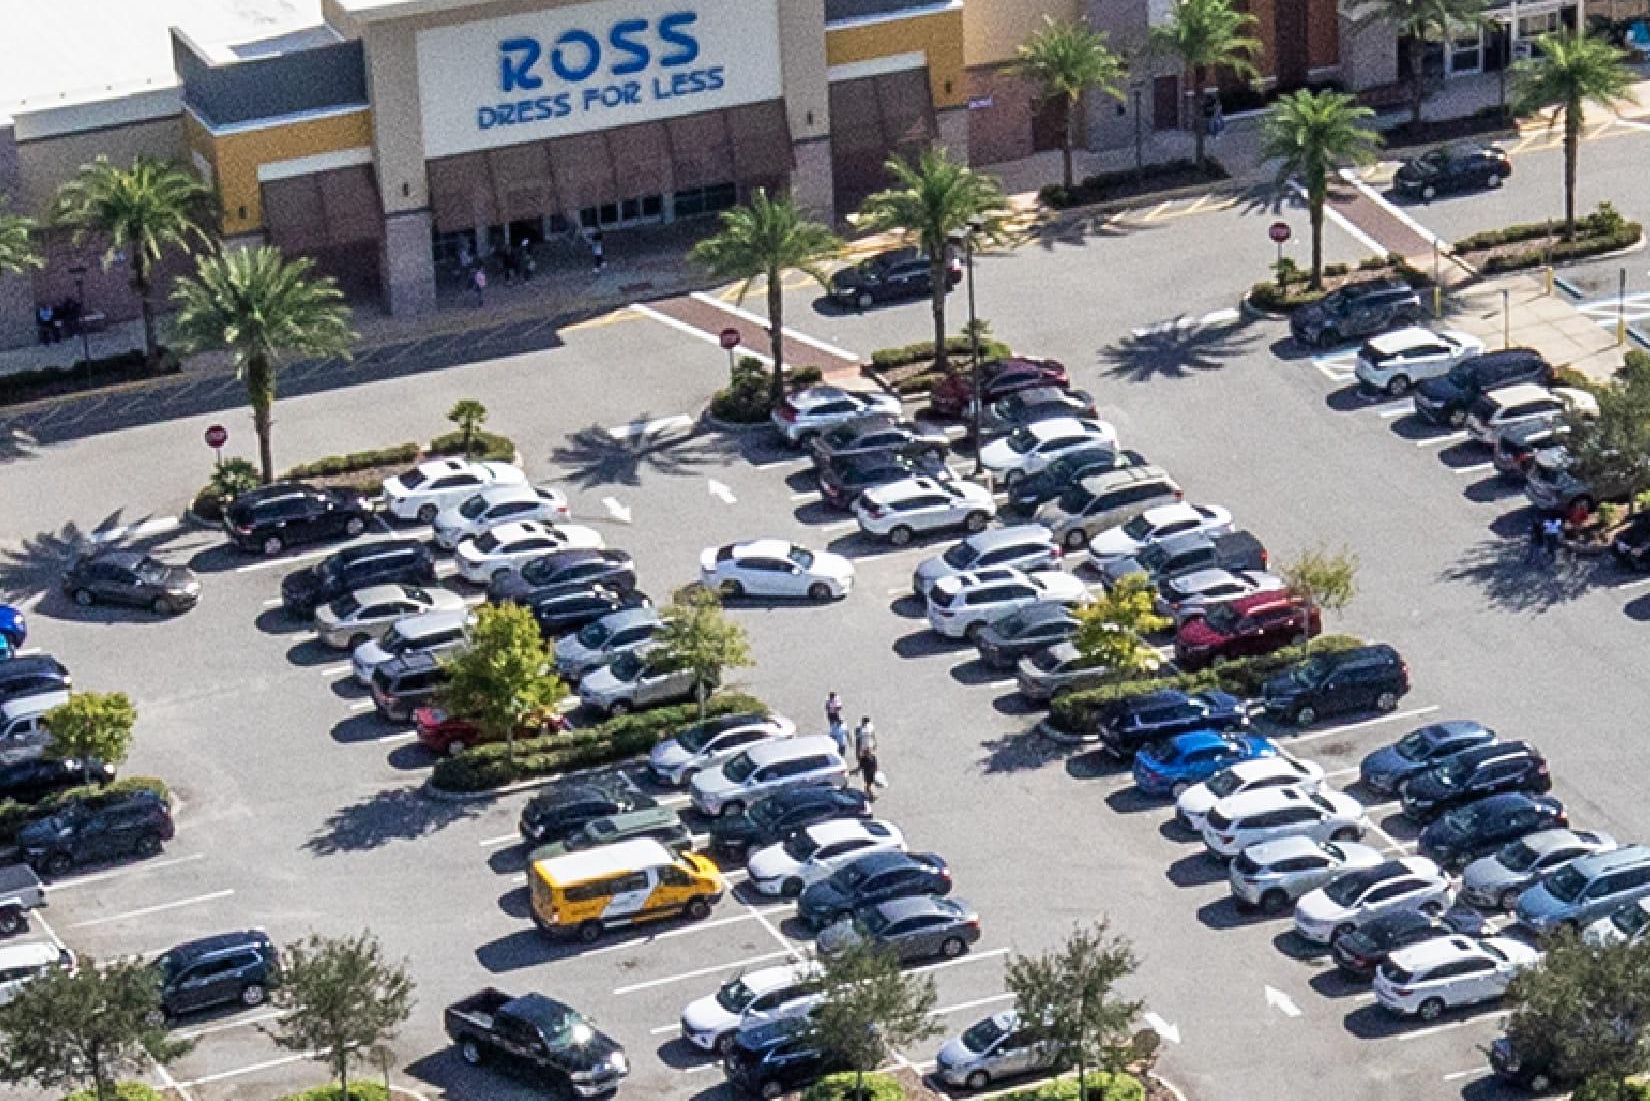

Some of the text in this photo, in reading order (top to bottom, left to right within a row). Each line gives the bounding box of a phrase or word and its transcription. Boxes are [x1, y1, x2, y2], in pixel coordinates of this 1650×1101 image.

[499, 11, 699, 92] ROSS
[477, 67, 725, 130] DRESS FOR LESS
